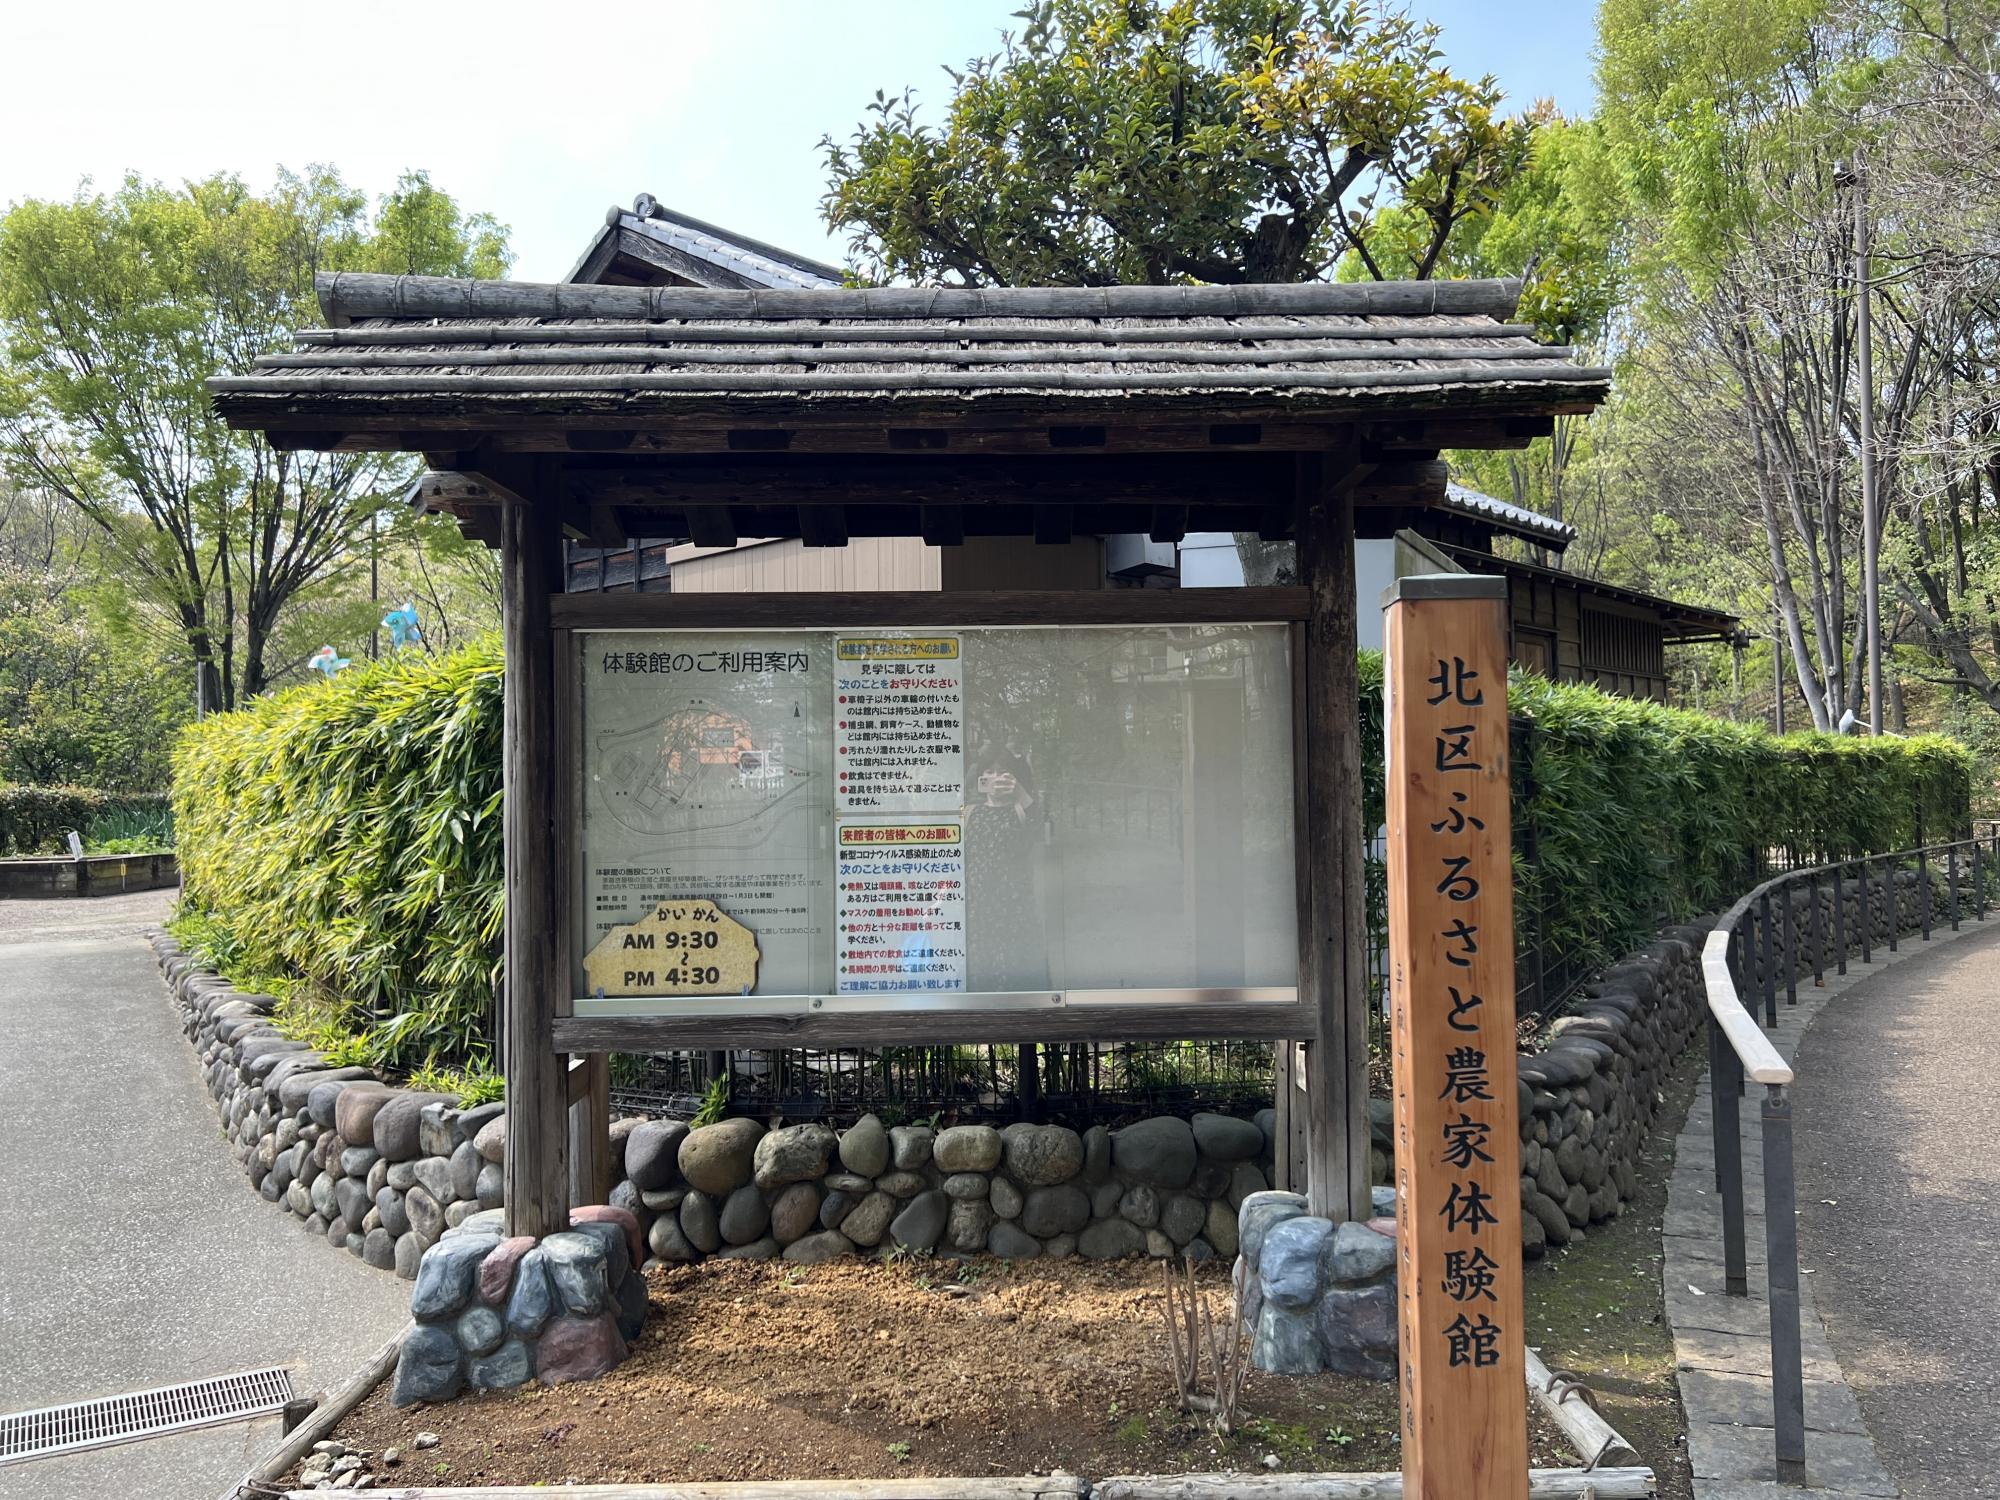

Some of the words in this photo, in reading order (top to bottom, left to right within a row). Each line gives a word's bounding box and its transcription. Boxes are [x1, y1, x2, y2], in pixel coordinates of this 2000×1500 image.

[602, 651, 809, 674] 体験館のご利用案内
[861, 663, 936, 675] 見学に際しては
[839, 679, 958, 690] 次のことをお守りください
[848, 694, 960, 704] 車椅子以外の車輪の付いたも
[847, 706, 953, 716] のは館内には持ち込めません。
[847, 732, 952, 742] どは館内には持ち込めません。
[848, 757, 938, 767] では館内には入れません。
[848, 771, 913, 781] 飲食はできません。
[848, 783, 961, 794] 遊具を持ち込んで遊ぶことはで
[848, 796, 881, 806] きません。
[842, 827, 956, 842] 来館者の皆様へのお願い
[840, 848, 961, 860] 新型コロナウイルス感染防止のため
[840, 863, 961, 875] 次のことをお守りください
[847, 892, 964, 903] ある方はご利用をご遠慮ください。
[848, 907, 944, 918] マスクの着用をお勧めします。
[848, 921, 962, 933] 他の方と十分な距離を保ってご見
[623, 934, 655, 949] AM
[665, 931, 719, 949] 9:30
[848, 936, 886, 945] 学ください。
[848, 948, 965, 960] 敷地内での飲食はご遠慮ください。
[848, 963, 956, 974] 長時間の見学はご遠慮ください。
[624, 971, 655, 986] PM
[665, 966, 720, 986] 4:30
[840, 979, 962, 991] ご理解ご協力お願い致します
[1426, 656, 1502, 1368] 北区ふるさと農家体験館
